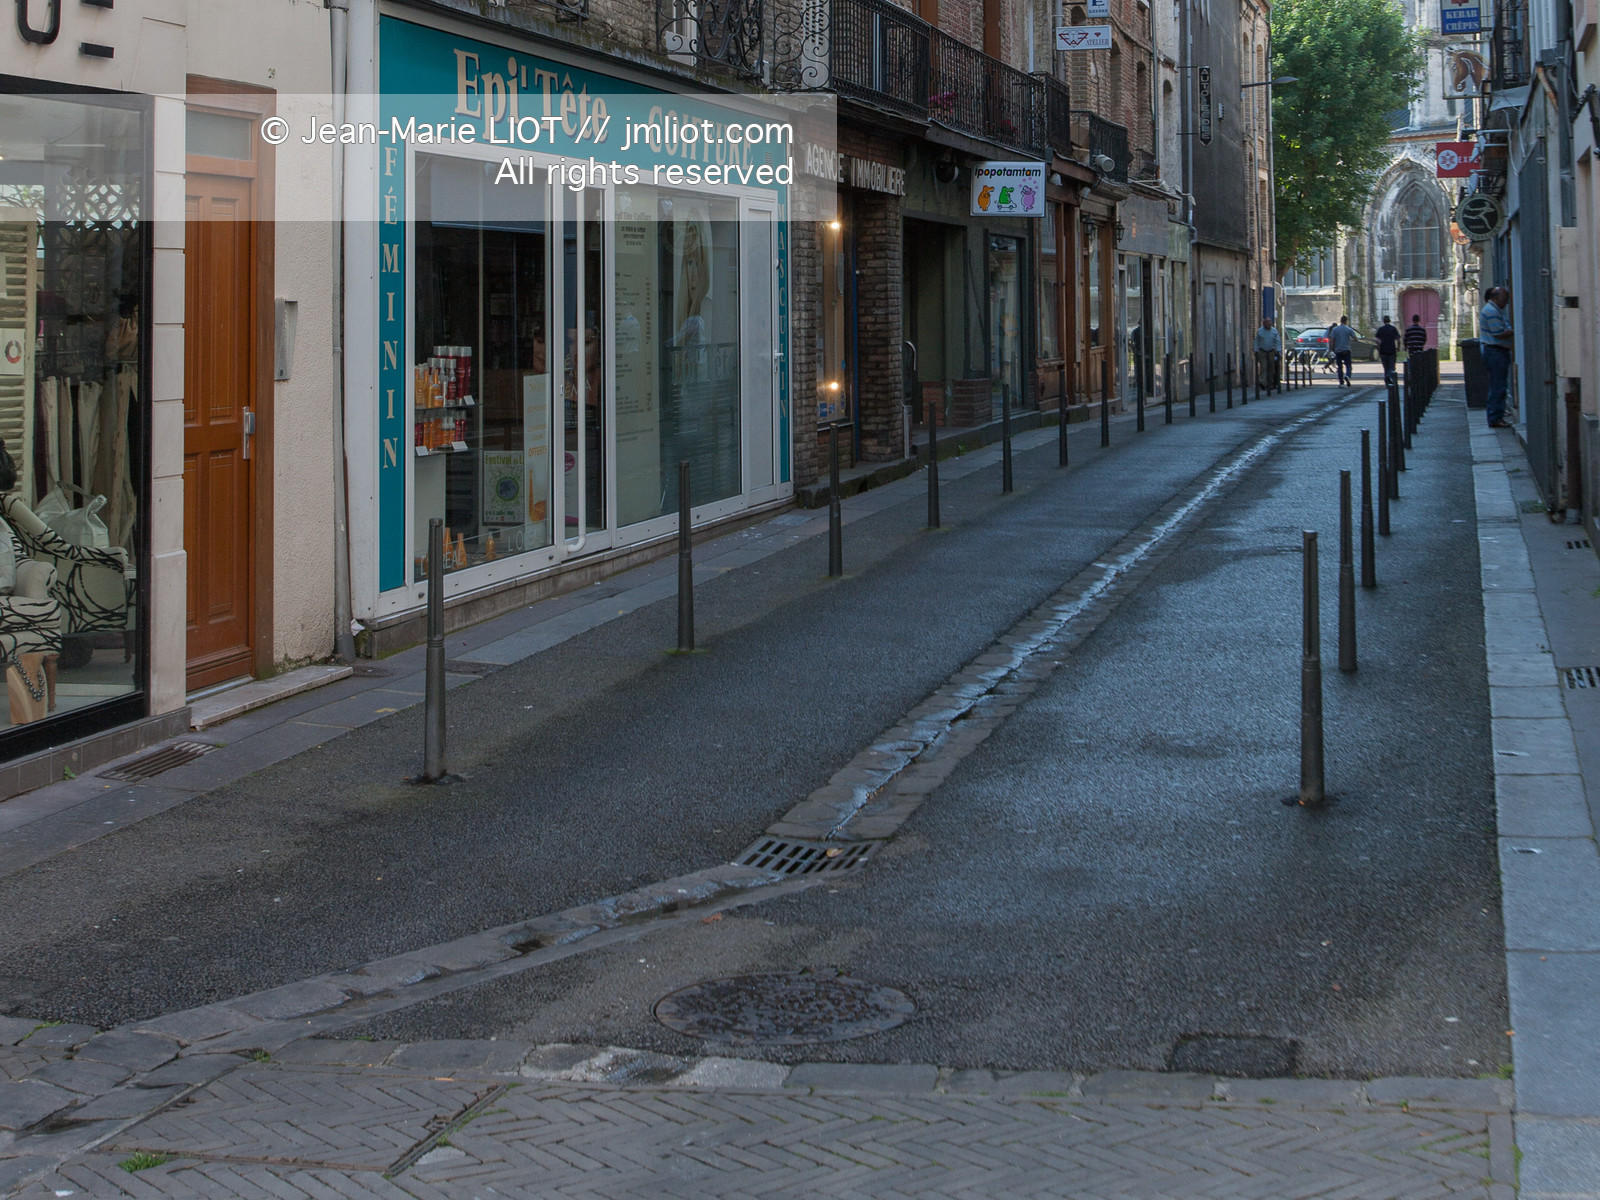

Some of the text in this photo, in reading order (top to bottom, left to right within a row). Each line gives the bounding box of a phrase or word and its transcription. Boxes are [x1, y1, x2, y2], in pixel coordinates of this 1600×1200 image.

[1445, 10, 1477, 19] KEBAB
[1445, 20, 1479, 31] CRÊPES
[648, 105, 754, 170] COIFFURE
[805, 142, 844, 183] AGENCE
[382, 146, 400, 469] FÉMININ
[778, 203, 787, 418] MASCULIN
[485, 455, 512, 464] Festival
